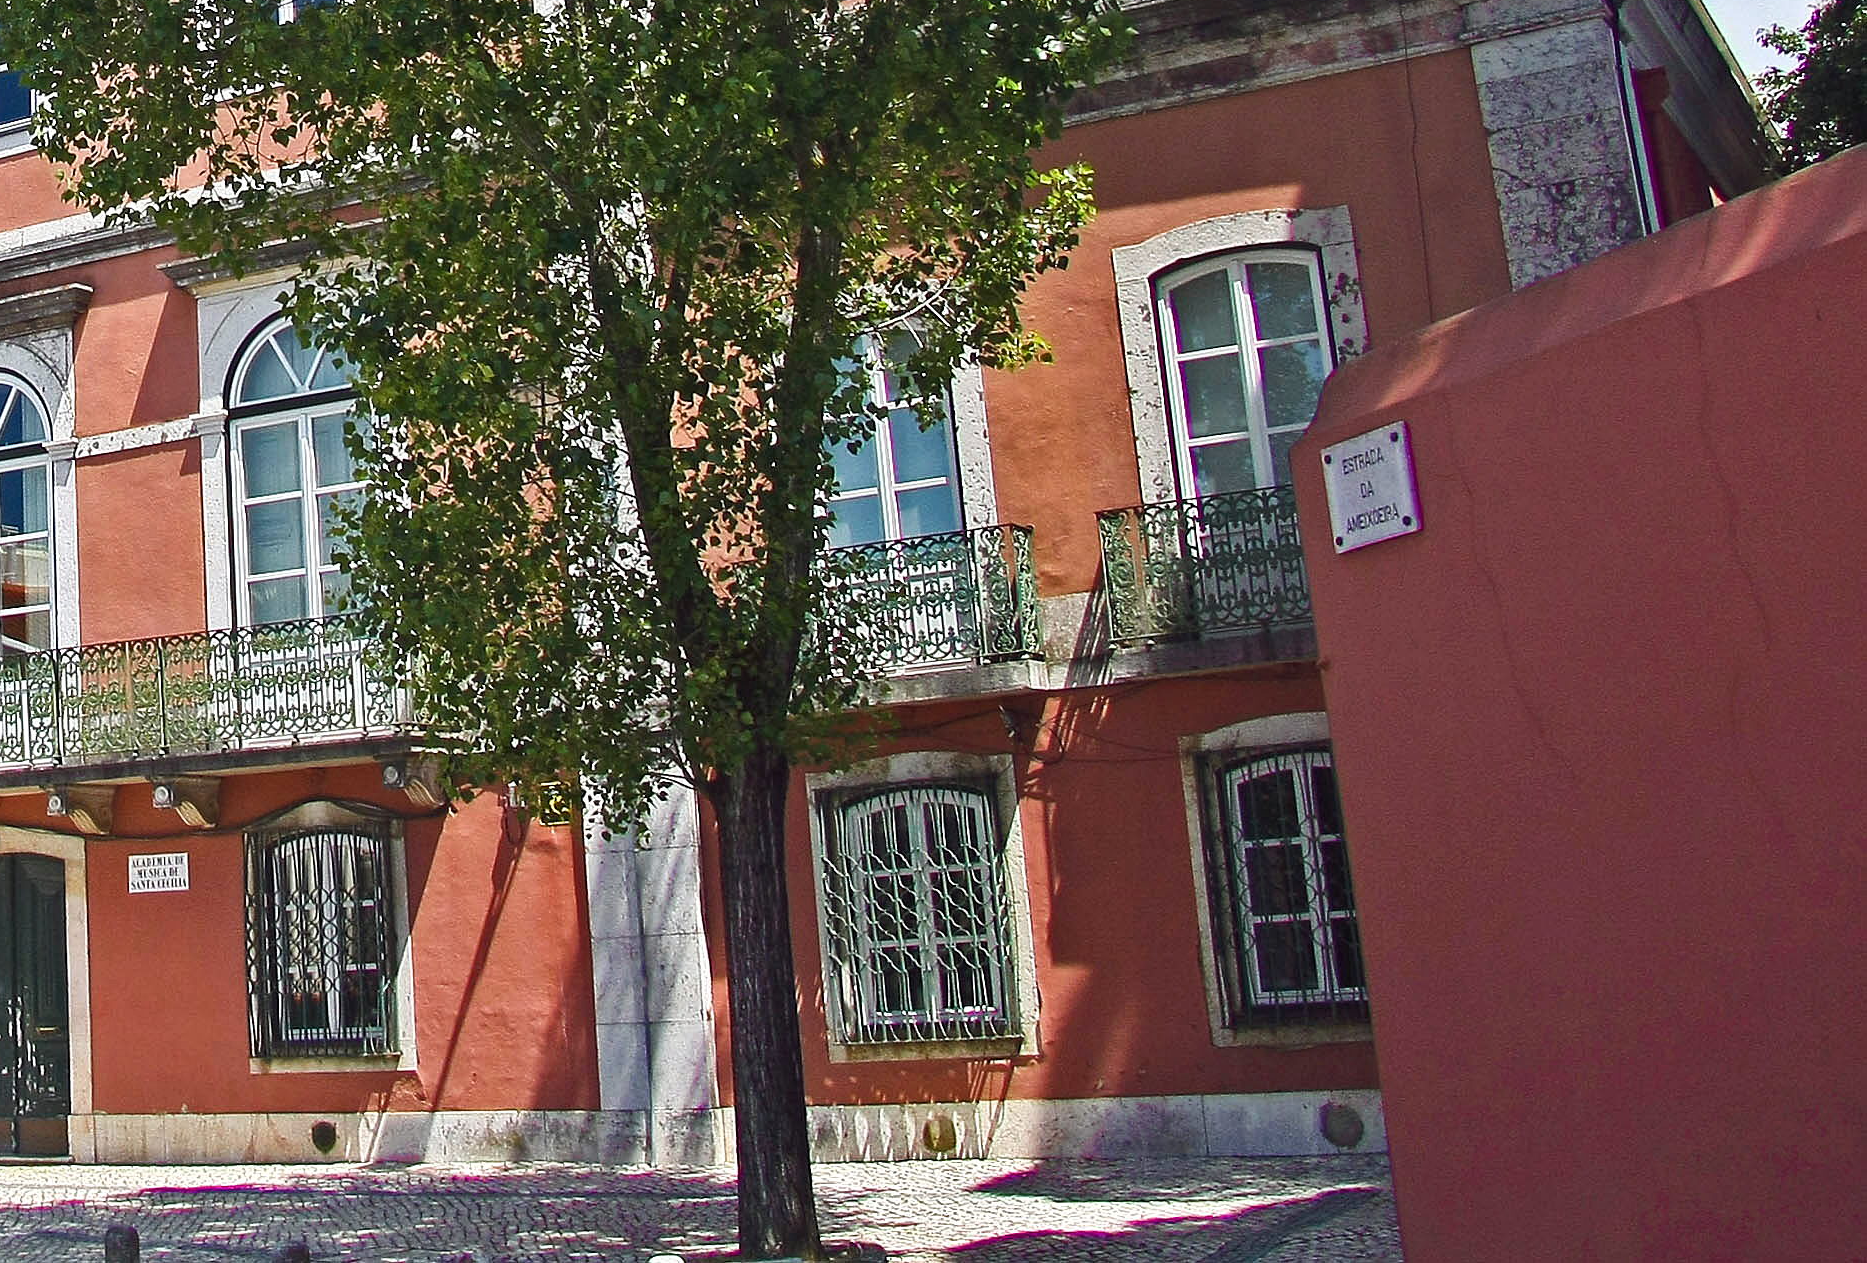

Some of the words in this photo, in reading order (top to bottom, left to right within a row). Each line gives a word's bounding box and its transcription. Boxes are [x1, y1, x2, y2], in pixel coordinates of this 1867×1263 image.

[1342, 447, 1385, 475] ESTRADA
[1360, 480, 1375, 498] DA
[1346, 501, 1400, 534] AMEIXOEIRA
[132, 856, 172, 868] ACADEMIA
[174, 855, 184, 866] DE
[169, 867, 179, 877] DE
[131, 879, 155, 890] SANTA
